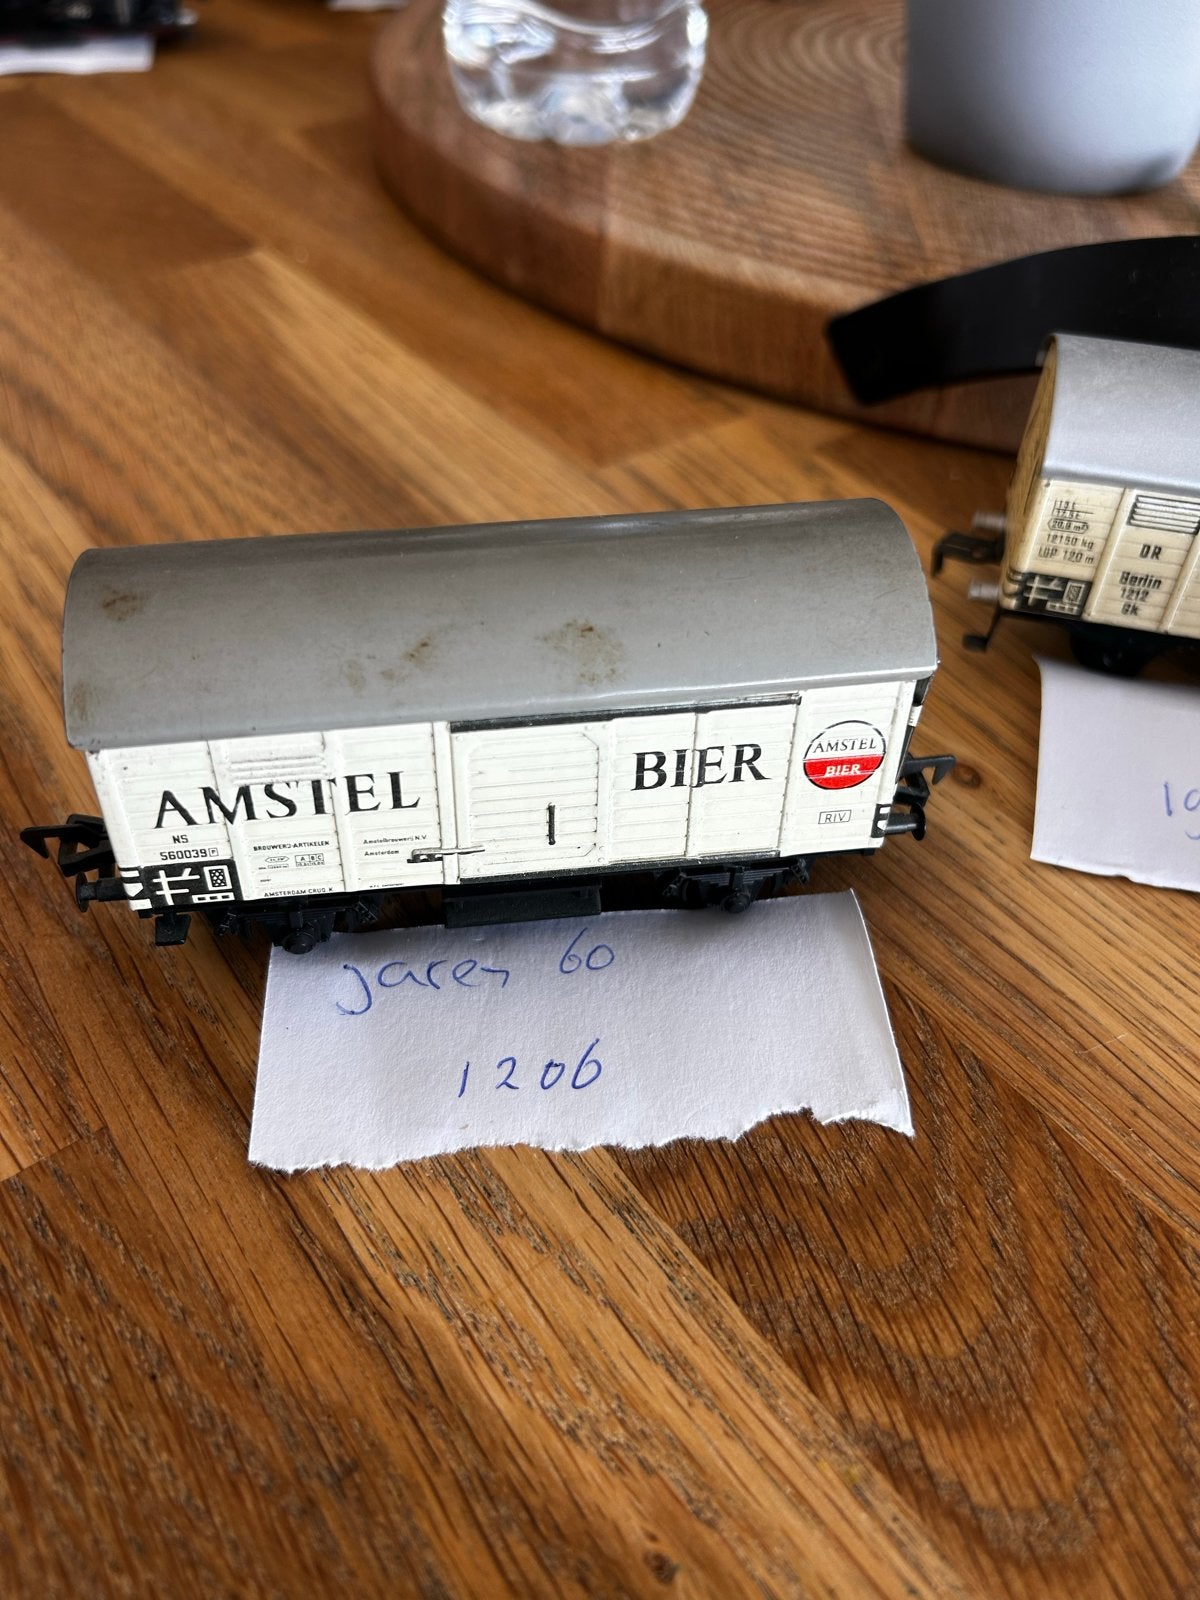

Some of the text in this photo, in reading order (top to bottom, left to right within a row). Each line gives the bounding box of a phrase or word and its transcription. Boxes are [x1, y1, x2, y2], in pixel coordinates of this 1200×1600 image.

[1081, 537, 1094, 552] kg
[1139, 543, 1162, 560] DR
[1119, 570, 1162, 589] Berlin
[813, 738, 877, 753] AMSTEL
[823, 763, 861, 778] BIER
[153, 743, 772, 829] AMSTEL BIER
[824, 812, 847, 823] RIV
[172, 834, 189, 844] NS
[160, 848, 208, 861] 560039
[559, 926, 615, 975] 60
[458, 1037, 603, 1098] 1206
